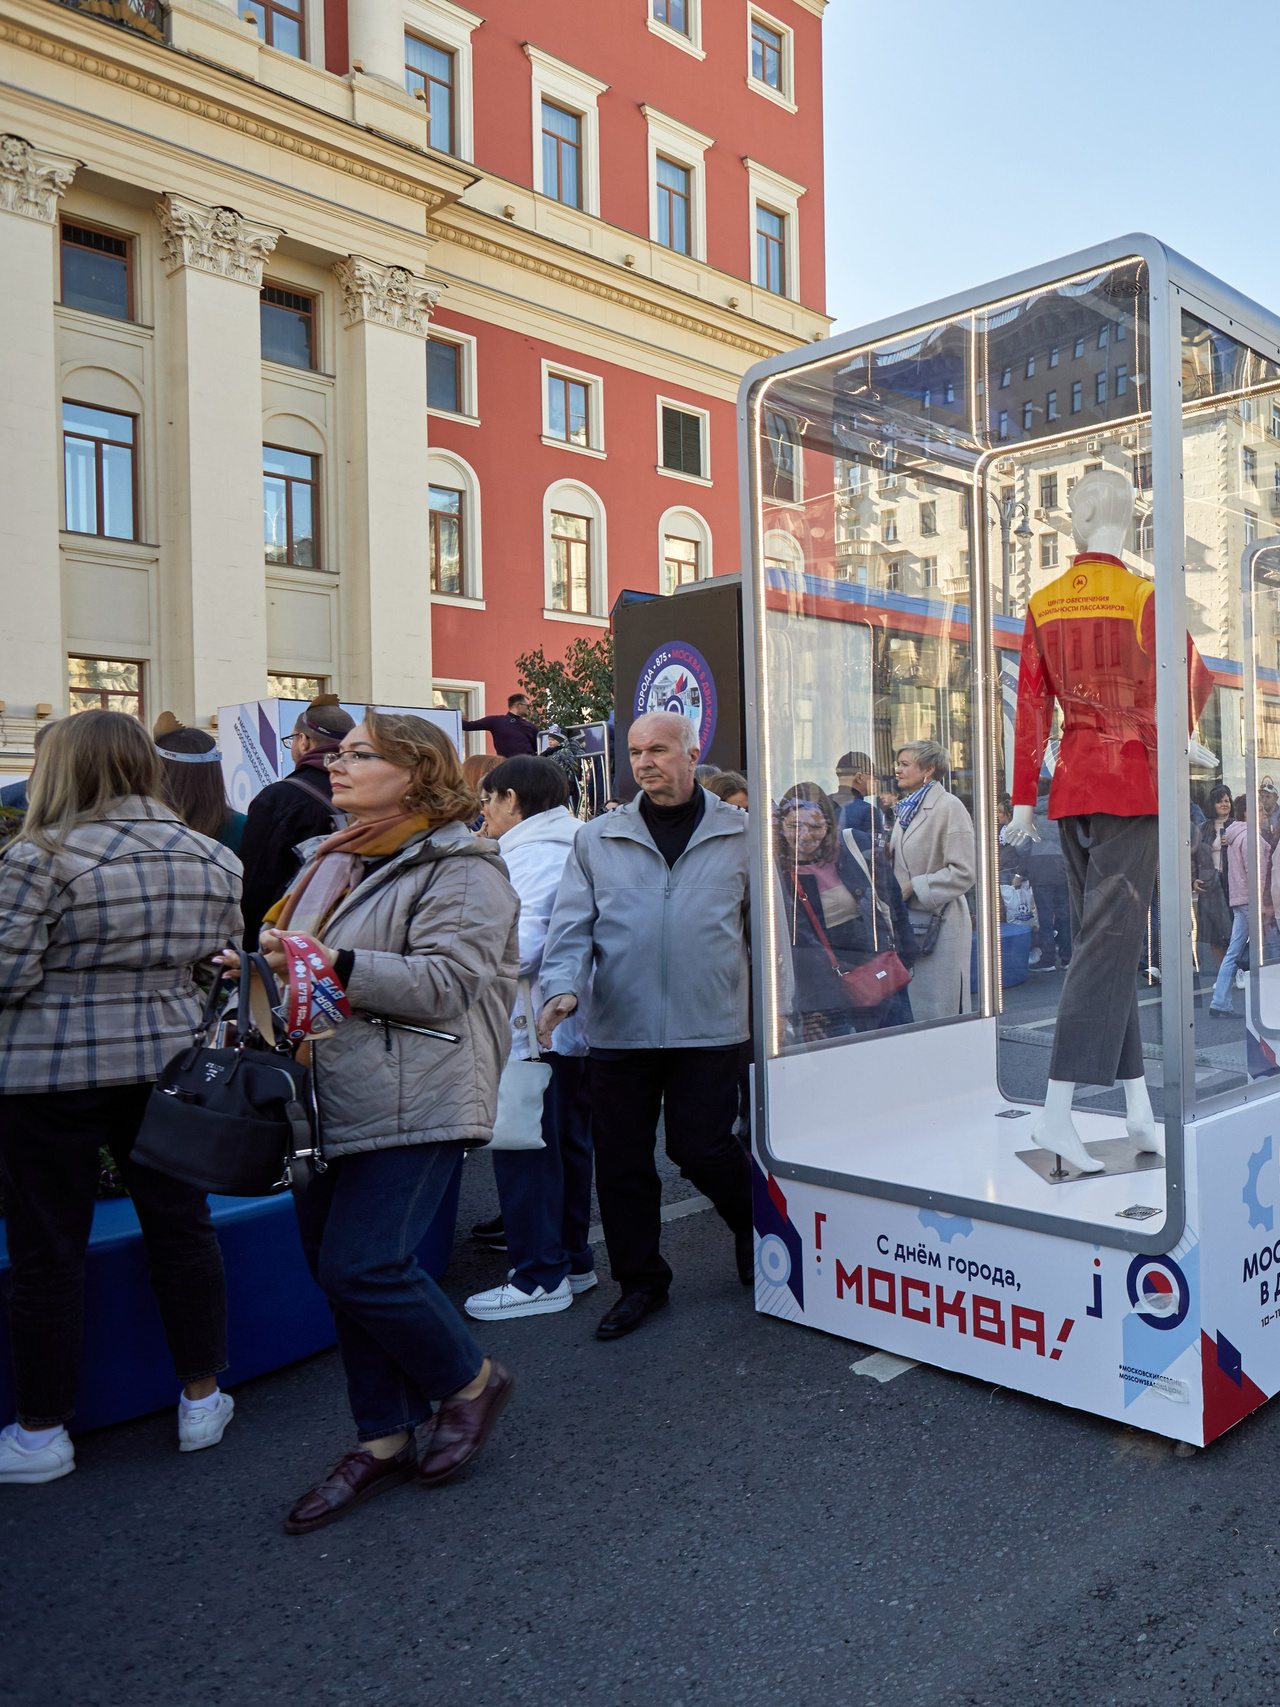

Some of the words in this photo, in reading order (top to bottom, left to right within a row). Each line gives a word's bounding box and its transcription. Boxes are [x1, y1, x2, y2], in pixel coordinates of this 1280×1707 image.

[1038, 606, 1078, 617] МОБИЛЬНОСТИ
[638, 668, 654, 712] ГОРОДА
[655, 652, 668, 667] 875
[672, 649, 700, 673] МОСКВА
[297, 982, 308, 1003] 875
[318, 976, 346, 1001] 875
[876, 1234, 889, 1255] С
[894, 1242, 942, 1269] днём
[948, 1255, 1022, 1292] города,
[1260, 1279, 1270, 1307] В
[835, 1258, 1076, 1361] МОСКВА!
